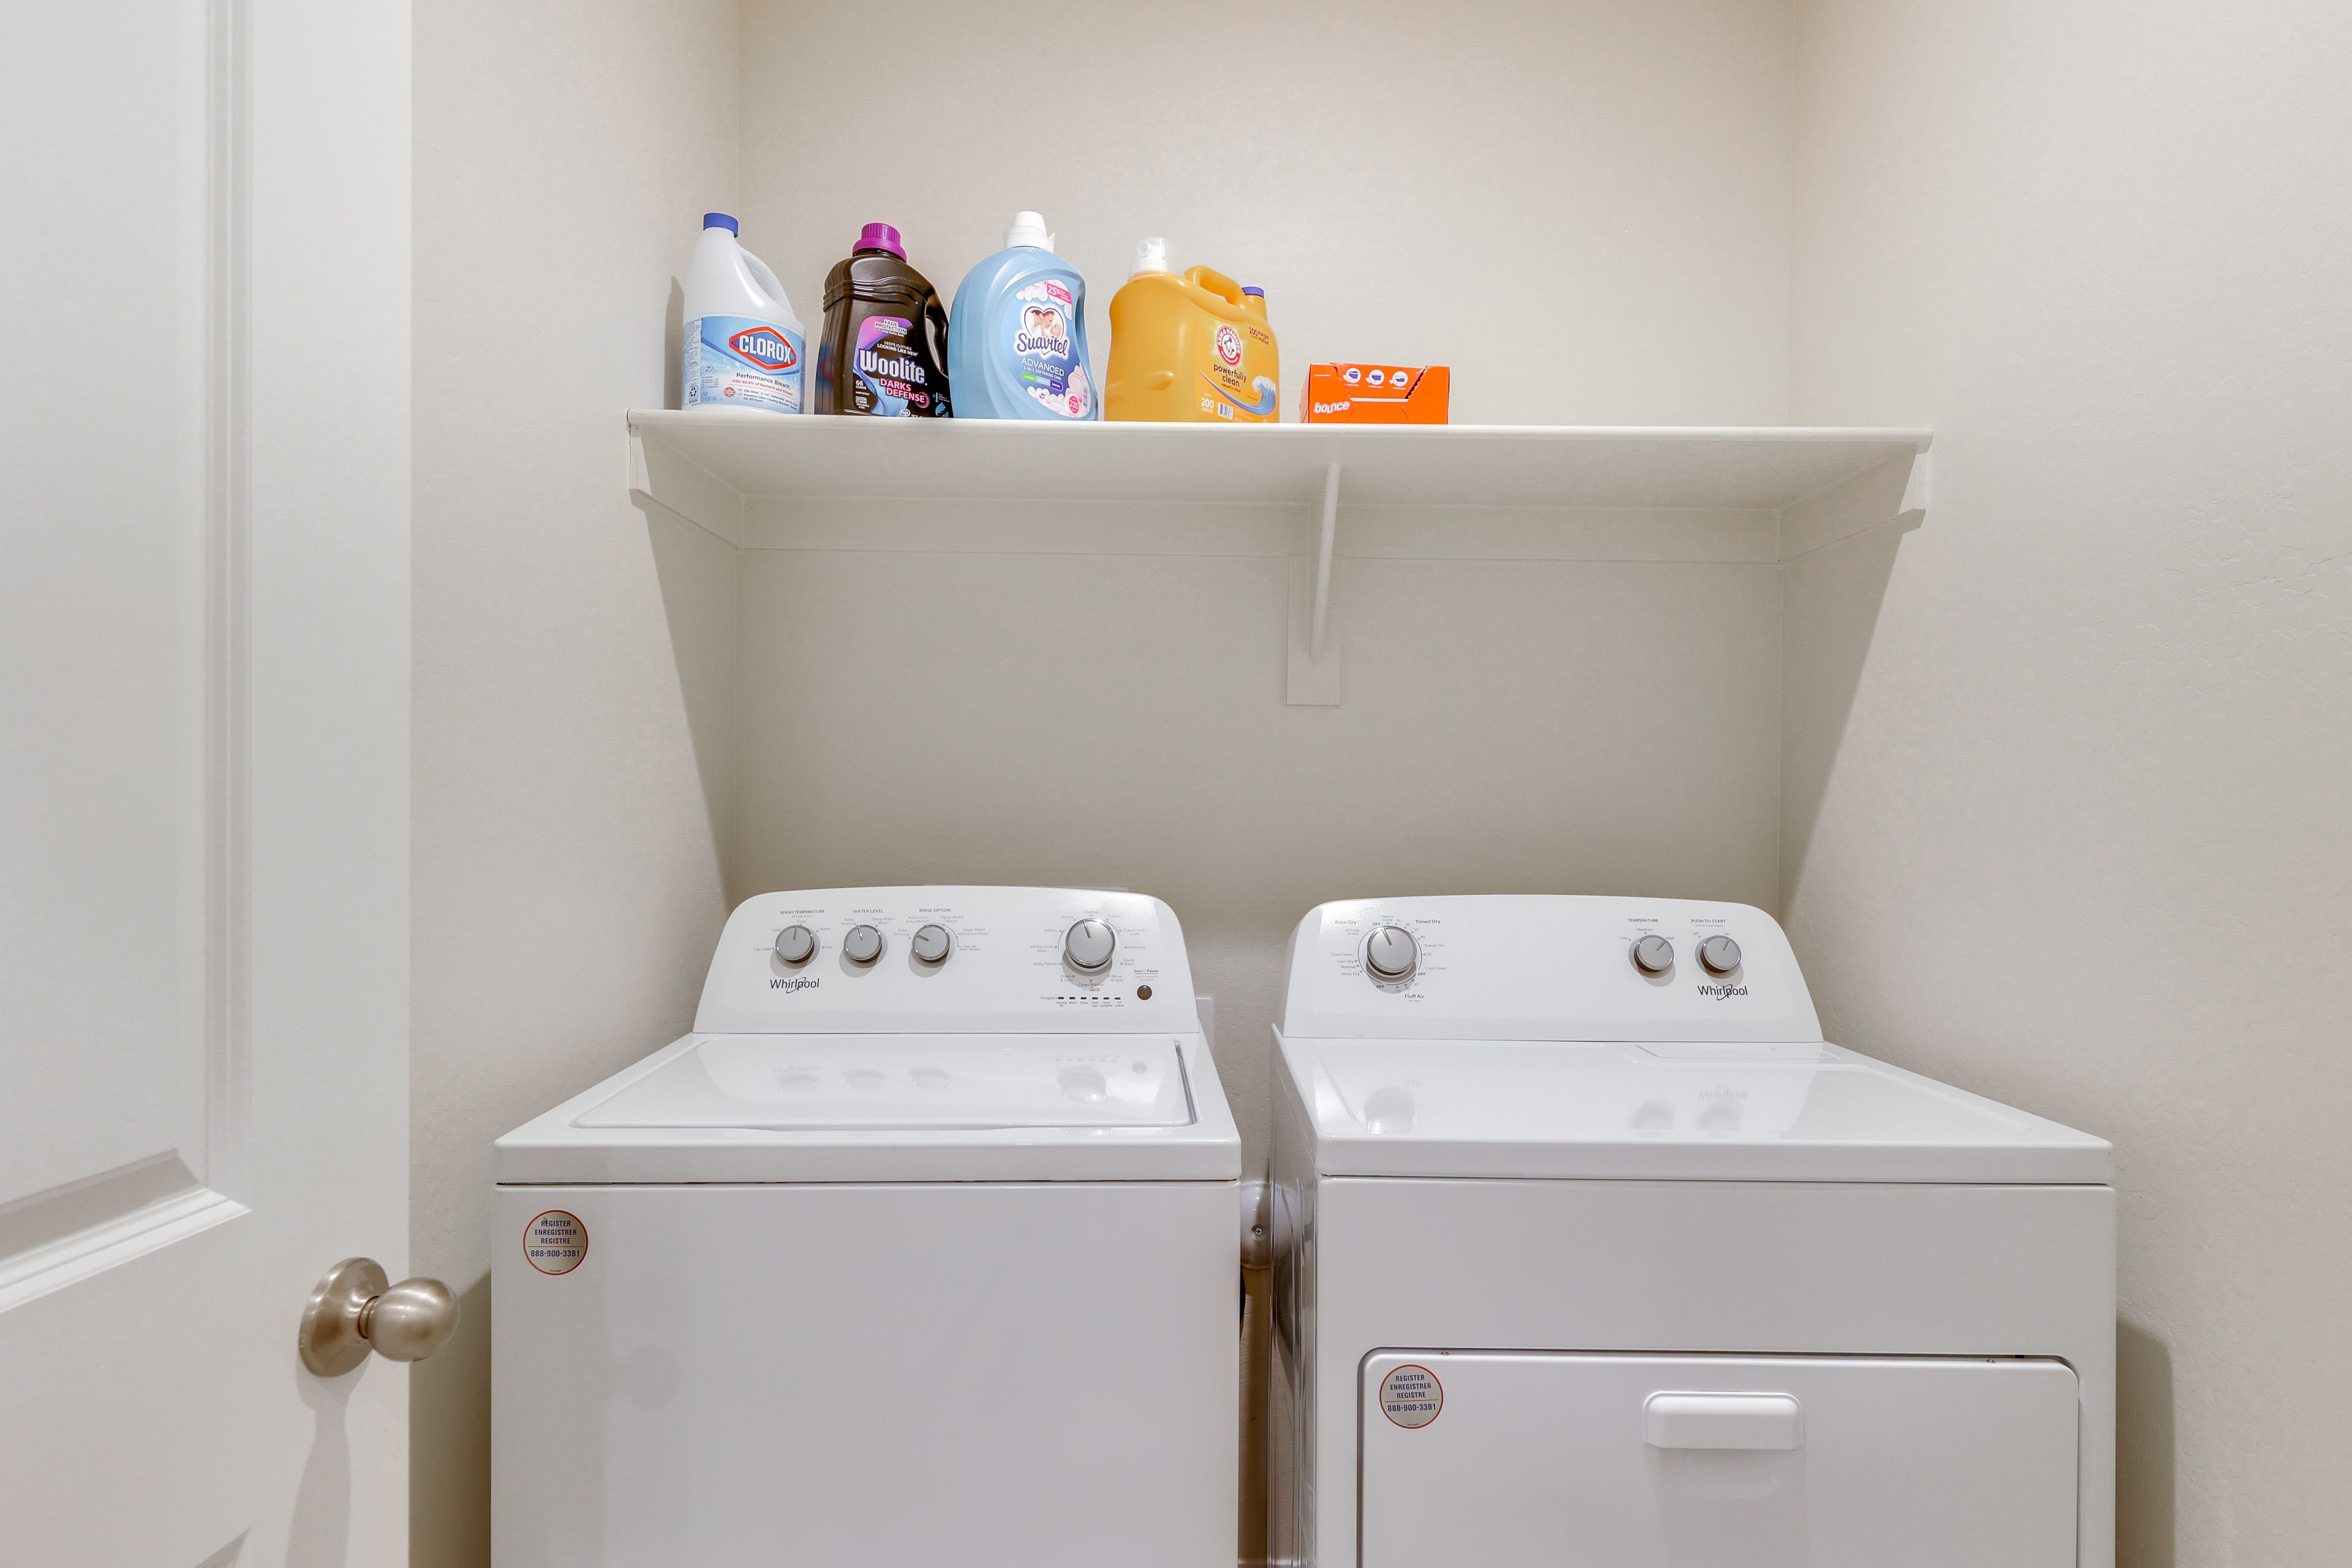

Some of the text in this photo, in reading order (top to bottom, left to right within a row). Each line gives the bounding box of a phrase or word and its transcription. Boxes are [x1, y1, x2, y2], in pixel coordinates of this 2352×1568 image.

[1048, 285, 1060, 295] 25%
[876, 323, 907, 333] PROTECTION
[1250, 327, 1258, 336] 200
[1017, 333, 1068, 356] Suavitel
[1226, 328, 1240, 354] HAMMER
[739, 334, 791, 364] CLOROX
[859, 350, 925, 383] Woolite
[1021, 358, 1065, 376] ADVANCED
[1035, 369, 1054, 378] SOFTENING
[1214, 364, 1247, 383] powerfully
[736, 372, 790, 389] Performance Bleach
[880, 378, 911, 391] DARKS
[1223, 375, 1240, 387] clean
[886, 387, 925, 403] DEFENSE
[1069, 400, 1079, 410] 235
[1201, 398, 1214, 409] 200
[1314, 402, 1349, 413] bounce
[770, 978, 820, 992] Whirlpool
[1697, 985, 1748, 999] Whirlpool
